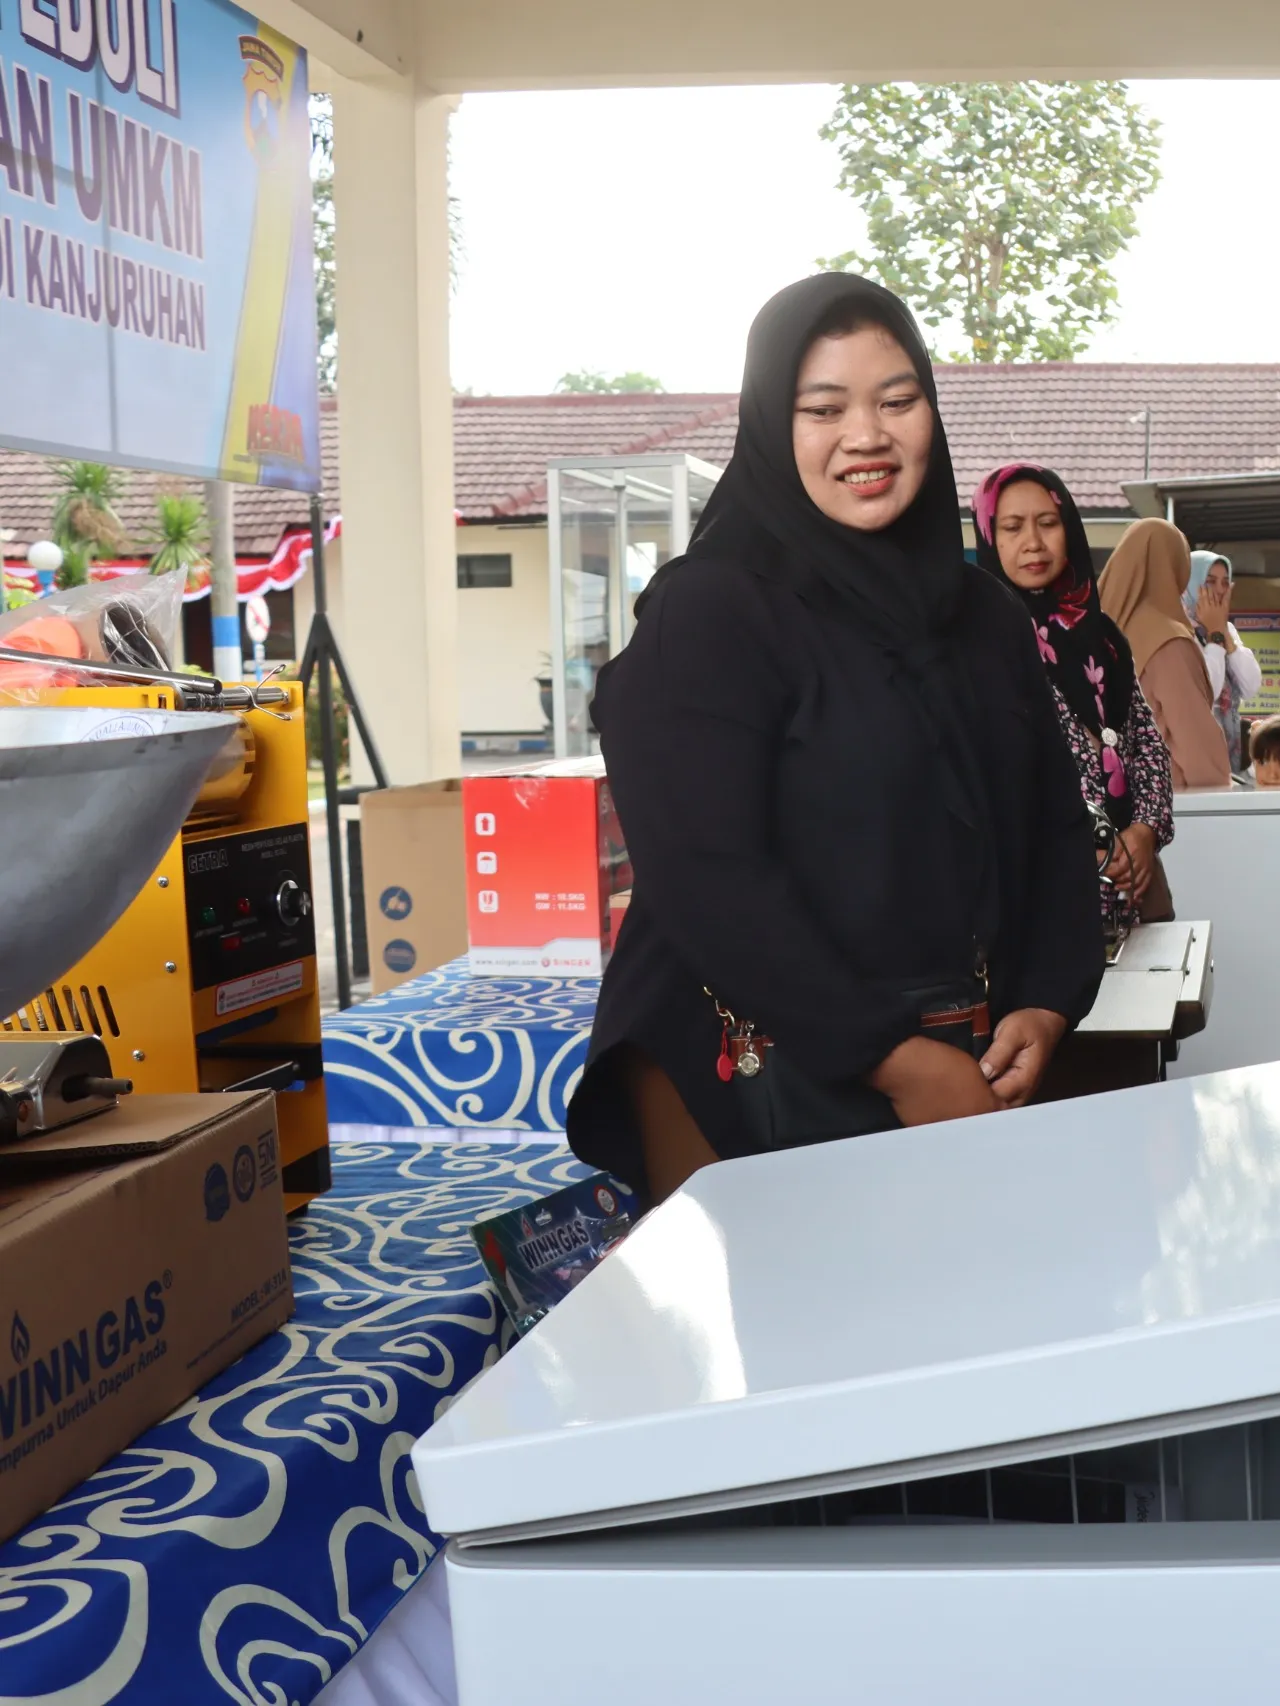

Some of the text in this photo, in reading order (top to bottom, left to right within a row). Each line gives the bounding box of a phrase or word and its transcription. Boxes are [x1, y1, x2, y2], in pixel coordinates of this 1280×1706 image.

[0, 0, 180, 119] DULI
[67, 90, 204, 260] UMKM
[23, 223, 206, 351] KANJURUHAN
[188, 849, 229, 873] GETRA
[553, 958, 591, 967] SINGER
[519, 1220, 590, 1269] WINN GAS
[96, 1280, 166, 1369] GAS
[56, 1387, 98, 1431] Untuk
[98, 1362, 136, 1402] Dapur
[138, 1338, 168, 1373] Anda
